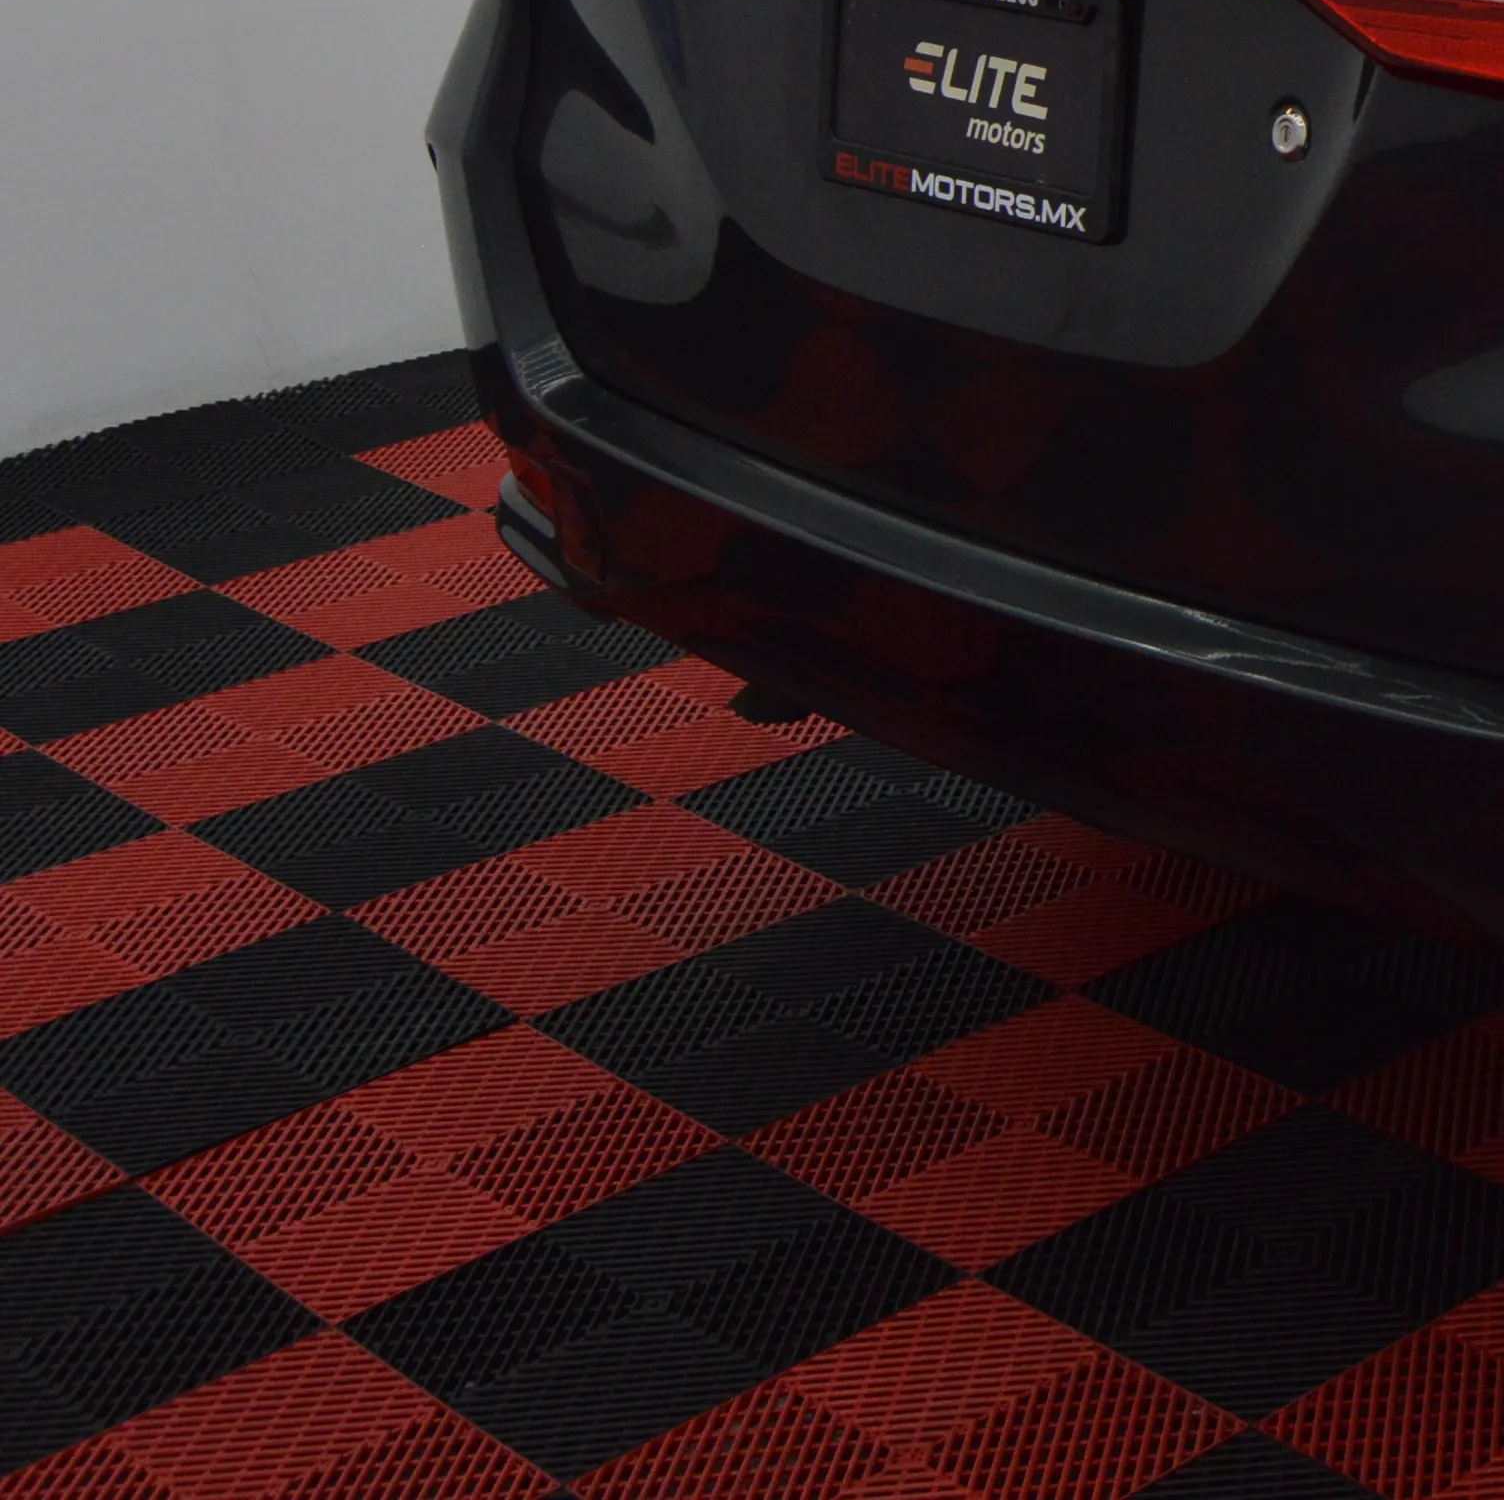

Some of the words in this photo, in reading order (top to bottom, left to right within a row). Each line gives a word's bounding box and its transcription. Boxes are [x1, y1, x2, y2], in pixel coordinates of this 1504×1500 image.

[903, 41, 1049, 120] ELITE
[966, 117, 1046, 155] motors
[834, 152, 1088, 233] ELITEMOTORS.MX
